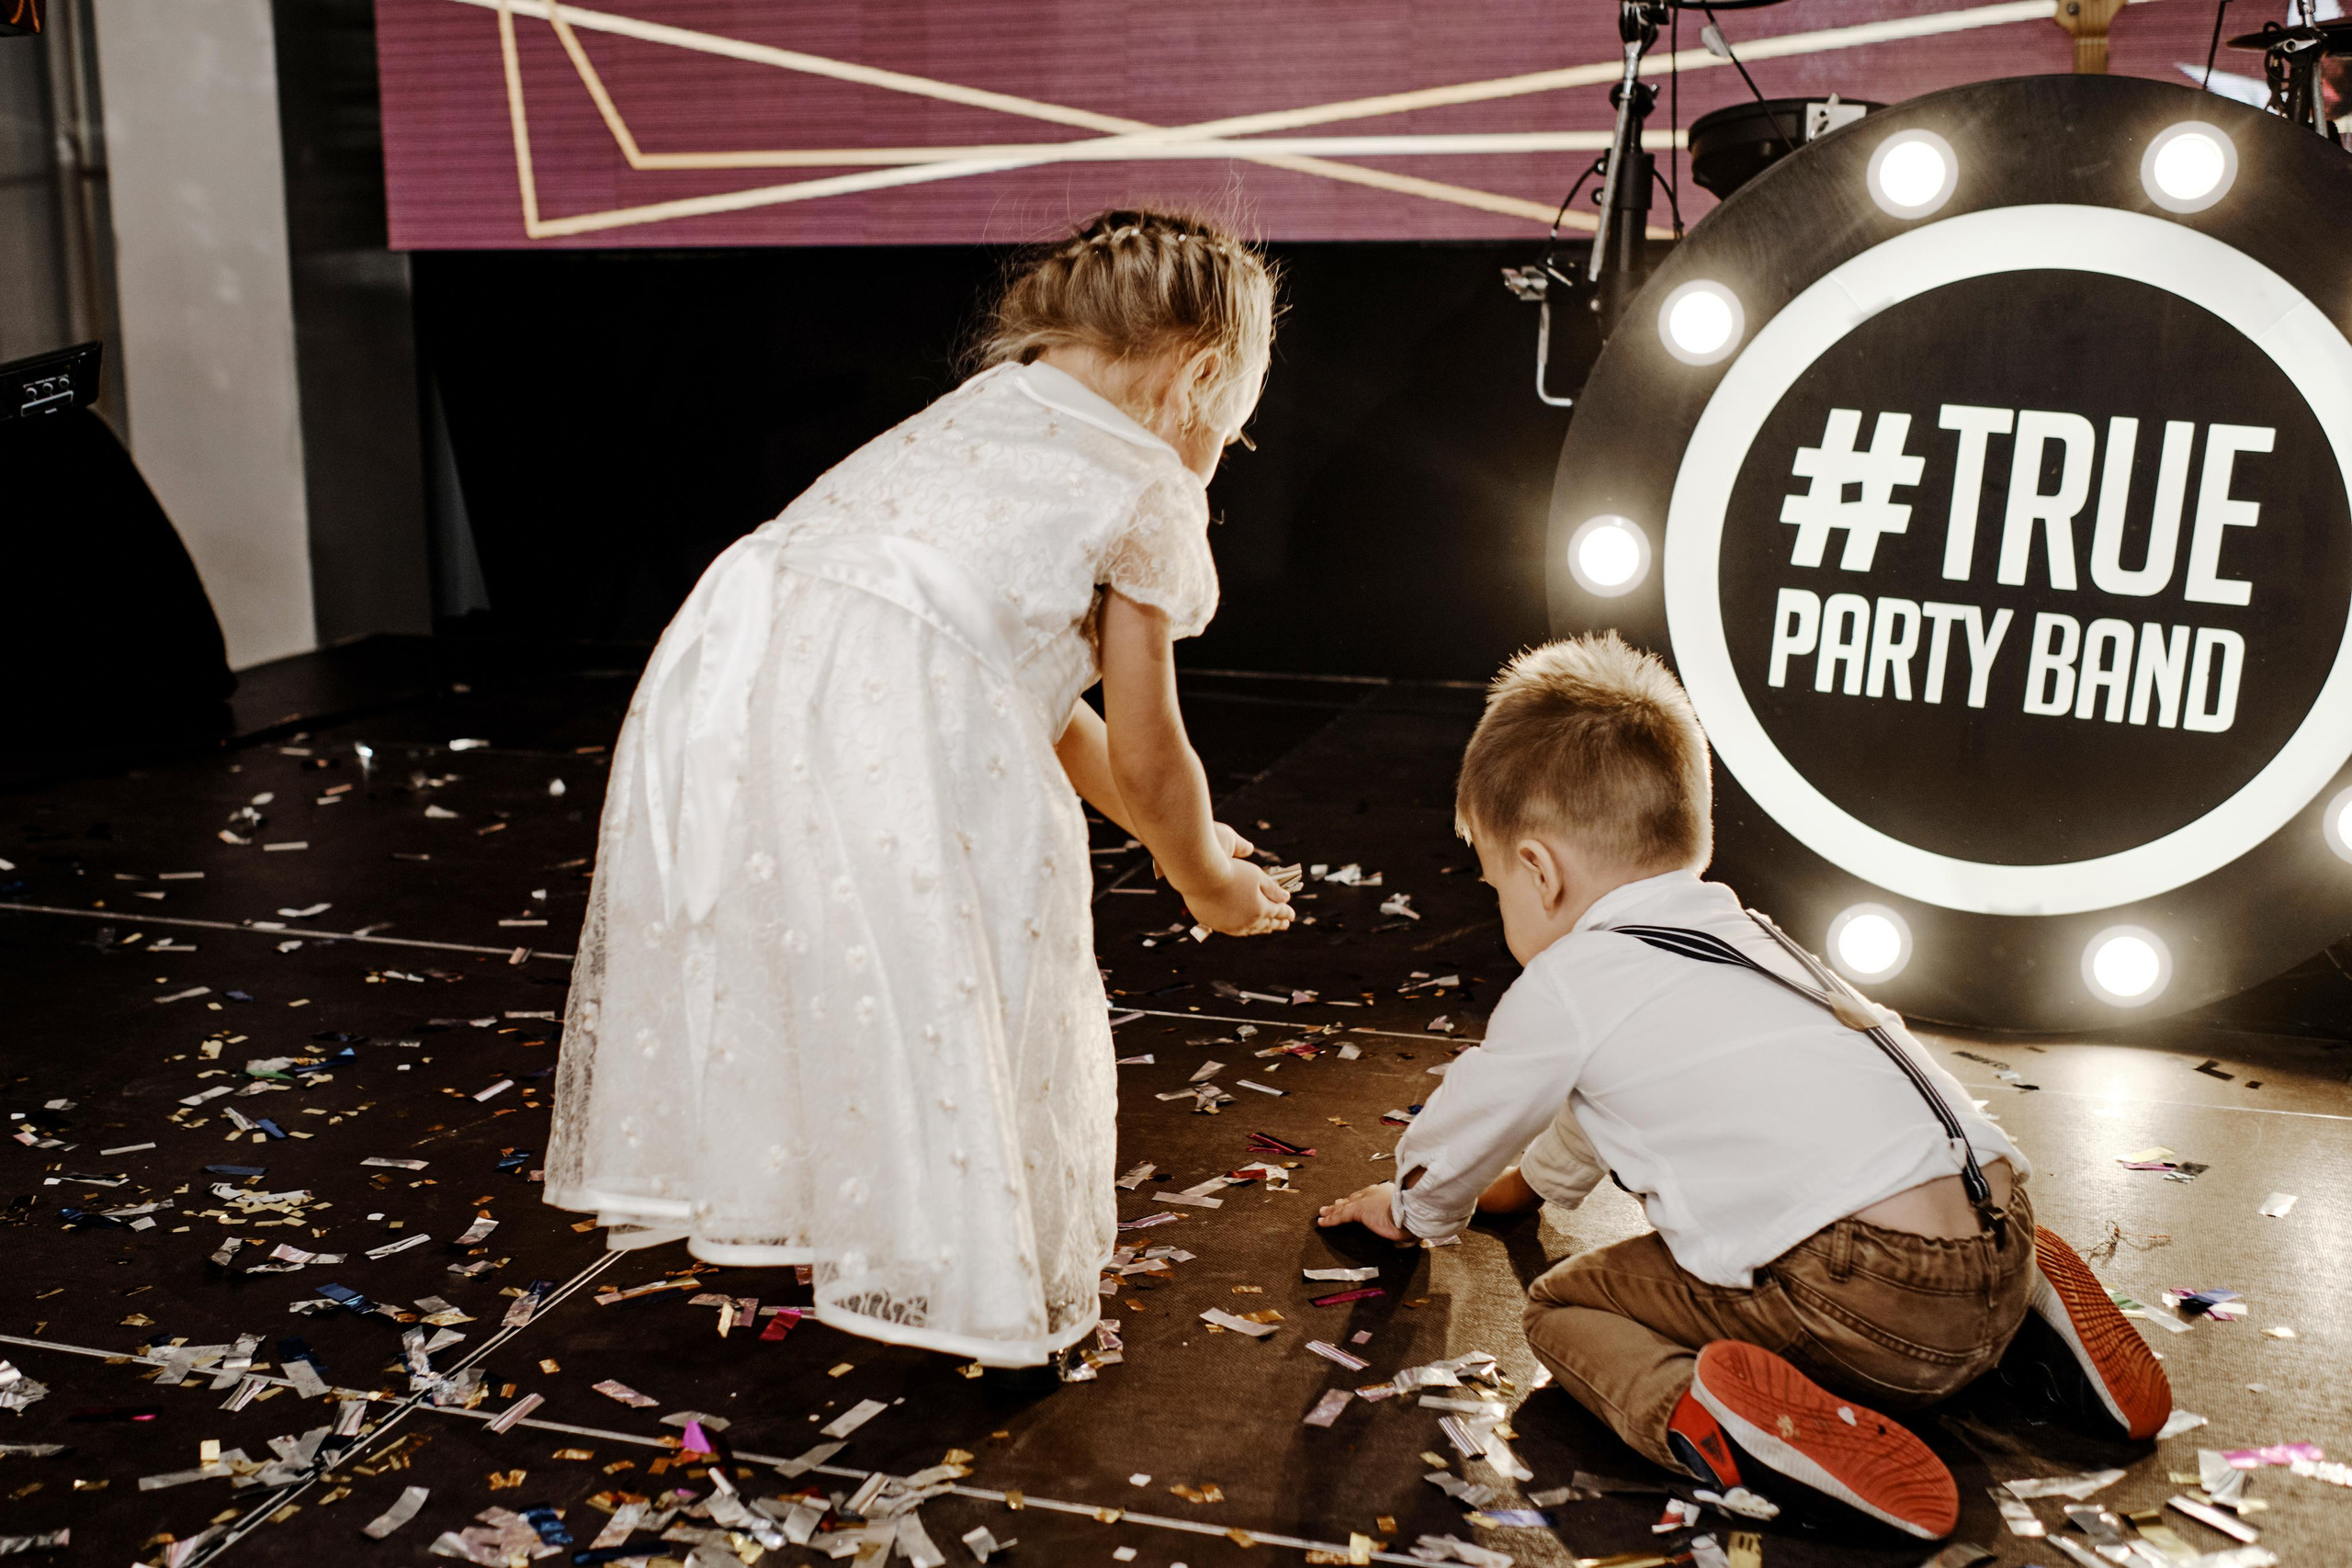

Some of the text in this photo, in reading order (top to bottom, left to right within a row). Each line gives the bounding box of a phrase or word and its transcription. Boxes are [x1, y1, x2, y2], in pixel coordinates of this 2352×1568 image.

[1780, 404, 2276, 606] #TRUE
[1768, 588, 2245, 733] PARTY BAND
